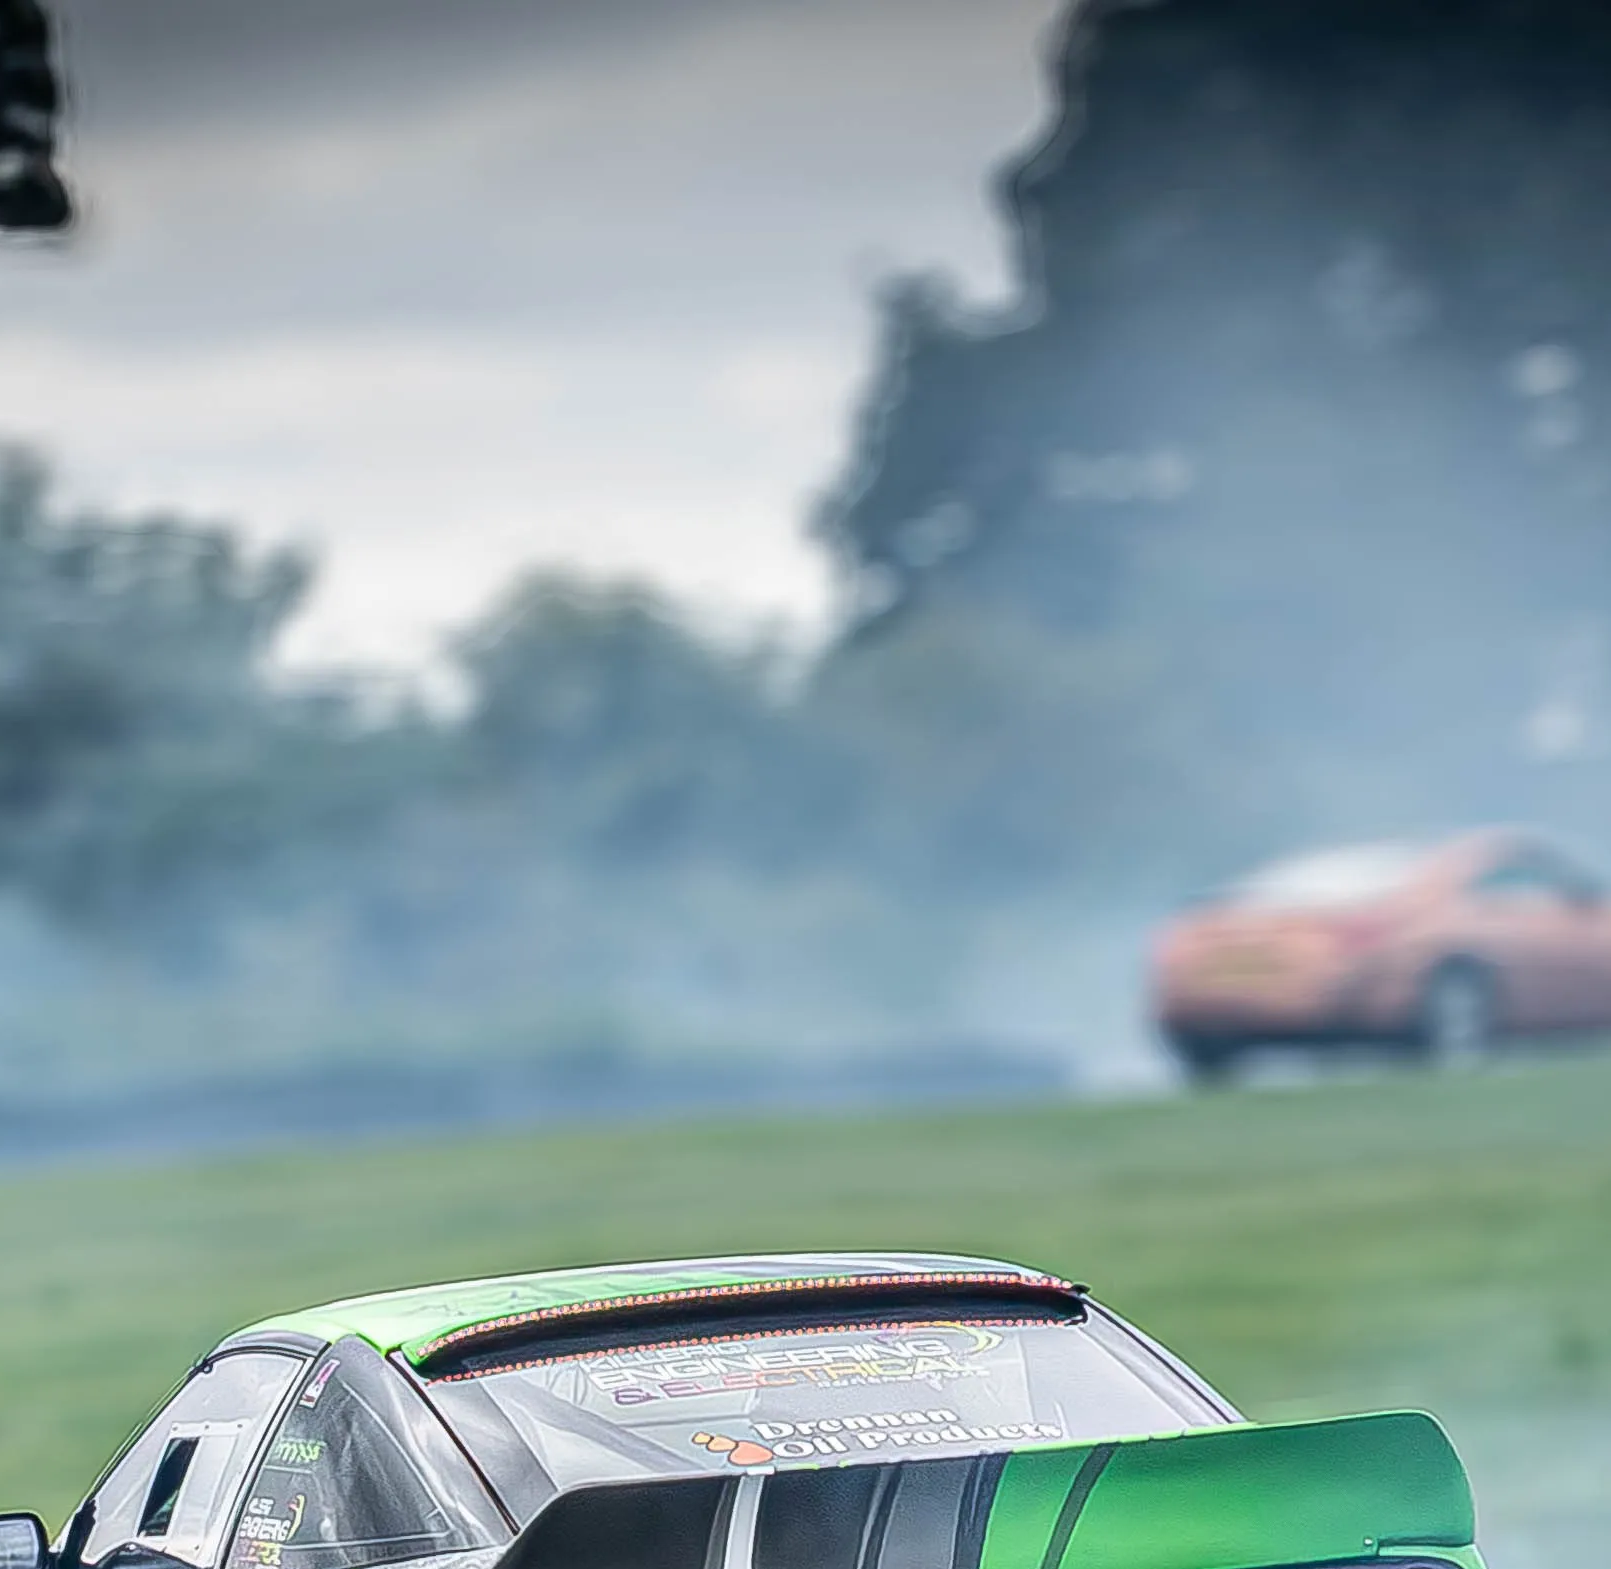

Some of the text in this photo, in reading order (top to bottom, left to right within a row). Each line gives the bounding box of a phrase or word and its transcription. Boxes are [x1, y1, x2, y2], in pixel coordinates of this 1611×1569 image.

[588, 1338, 952, 1390] ENGINEERING
[658, 1356, 986, 1398] ELECTRICAL
[753, 1407, 959, 1440] Drennan
[772, 1422, 1064, 1458] Oil Products
